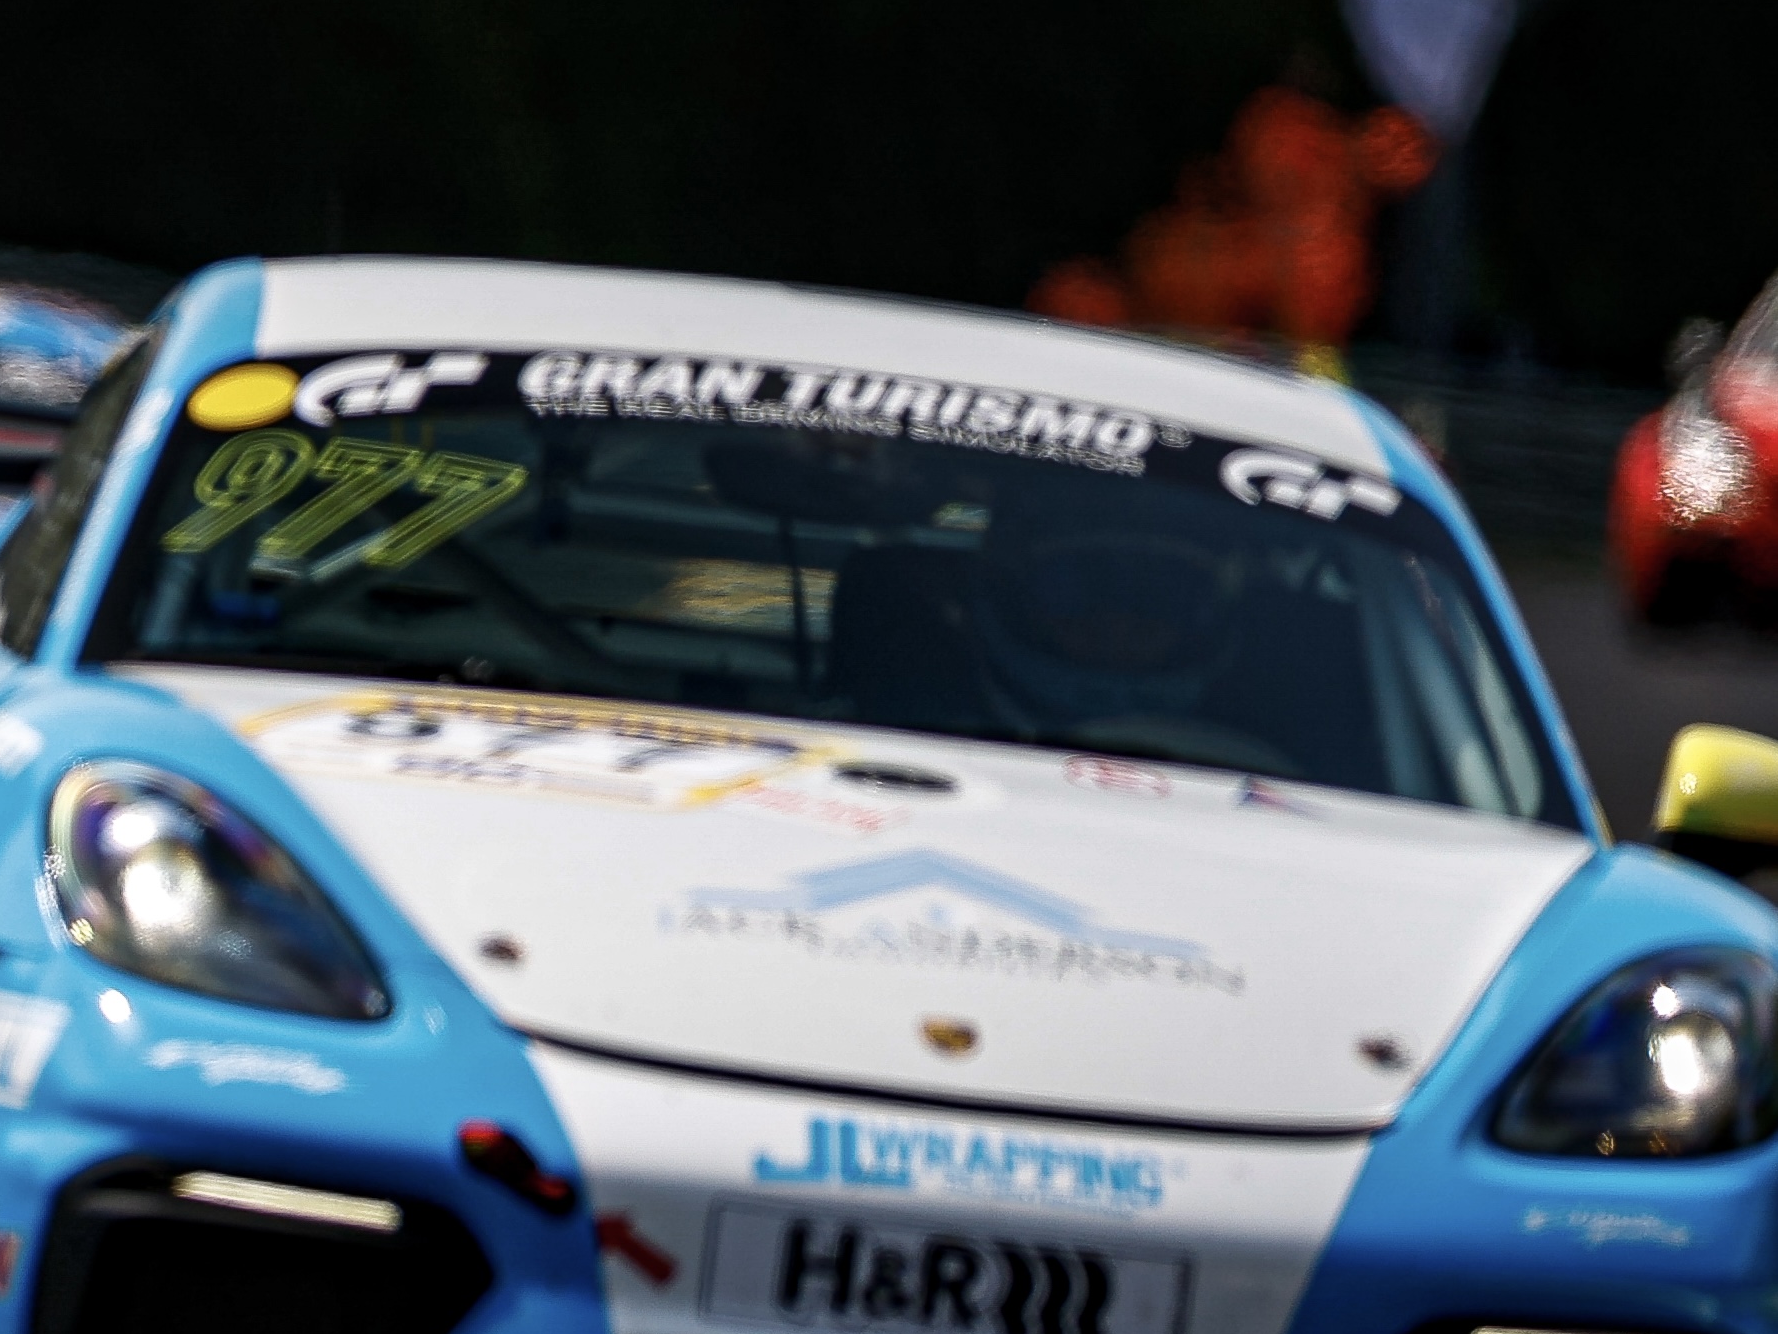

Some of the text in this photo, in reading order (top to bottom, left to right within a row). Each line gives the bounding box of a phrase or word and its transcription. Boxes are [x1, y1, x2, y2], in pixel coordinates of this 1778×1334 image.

[518, 351, 765, 402] GRAN
[161, 428, 528, 567] 977
[779, 1216, 981, 1331] H&R
